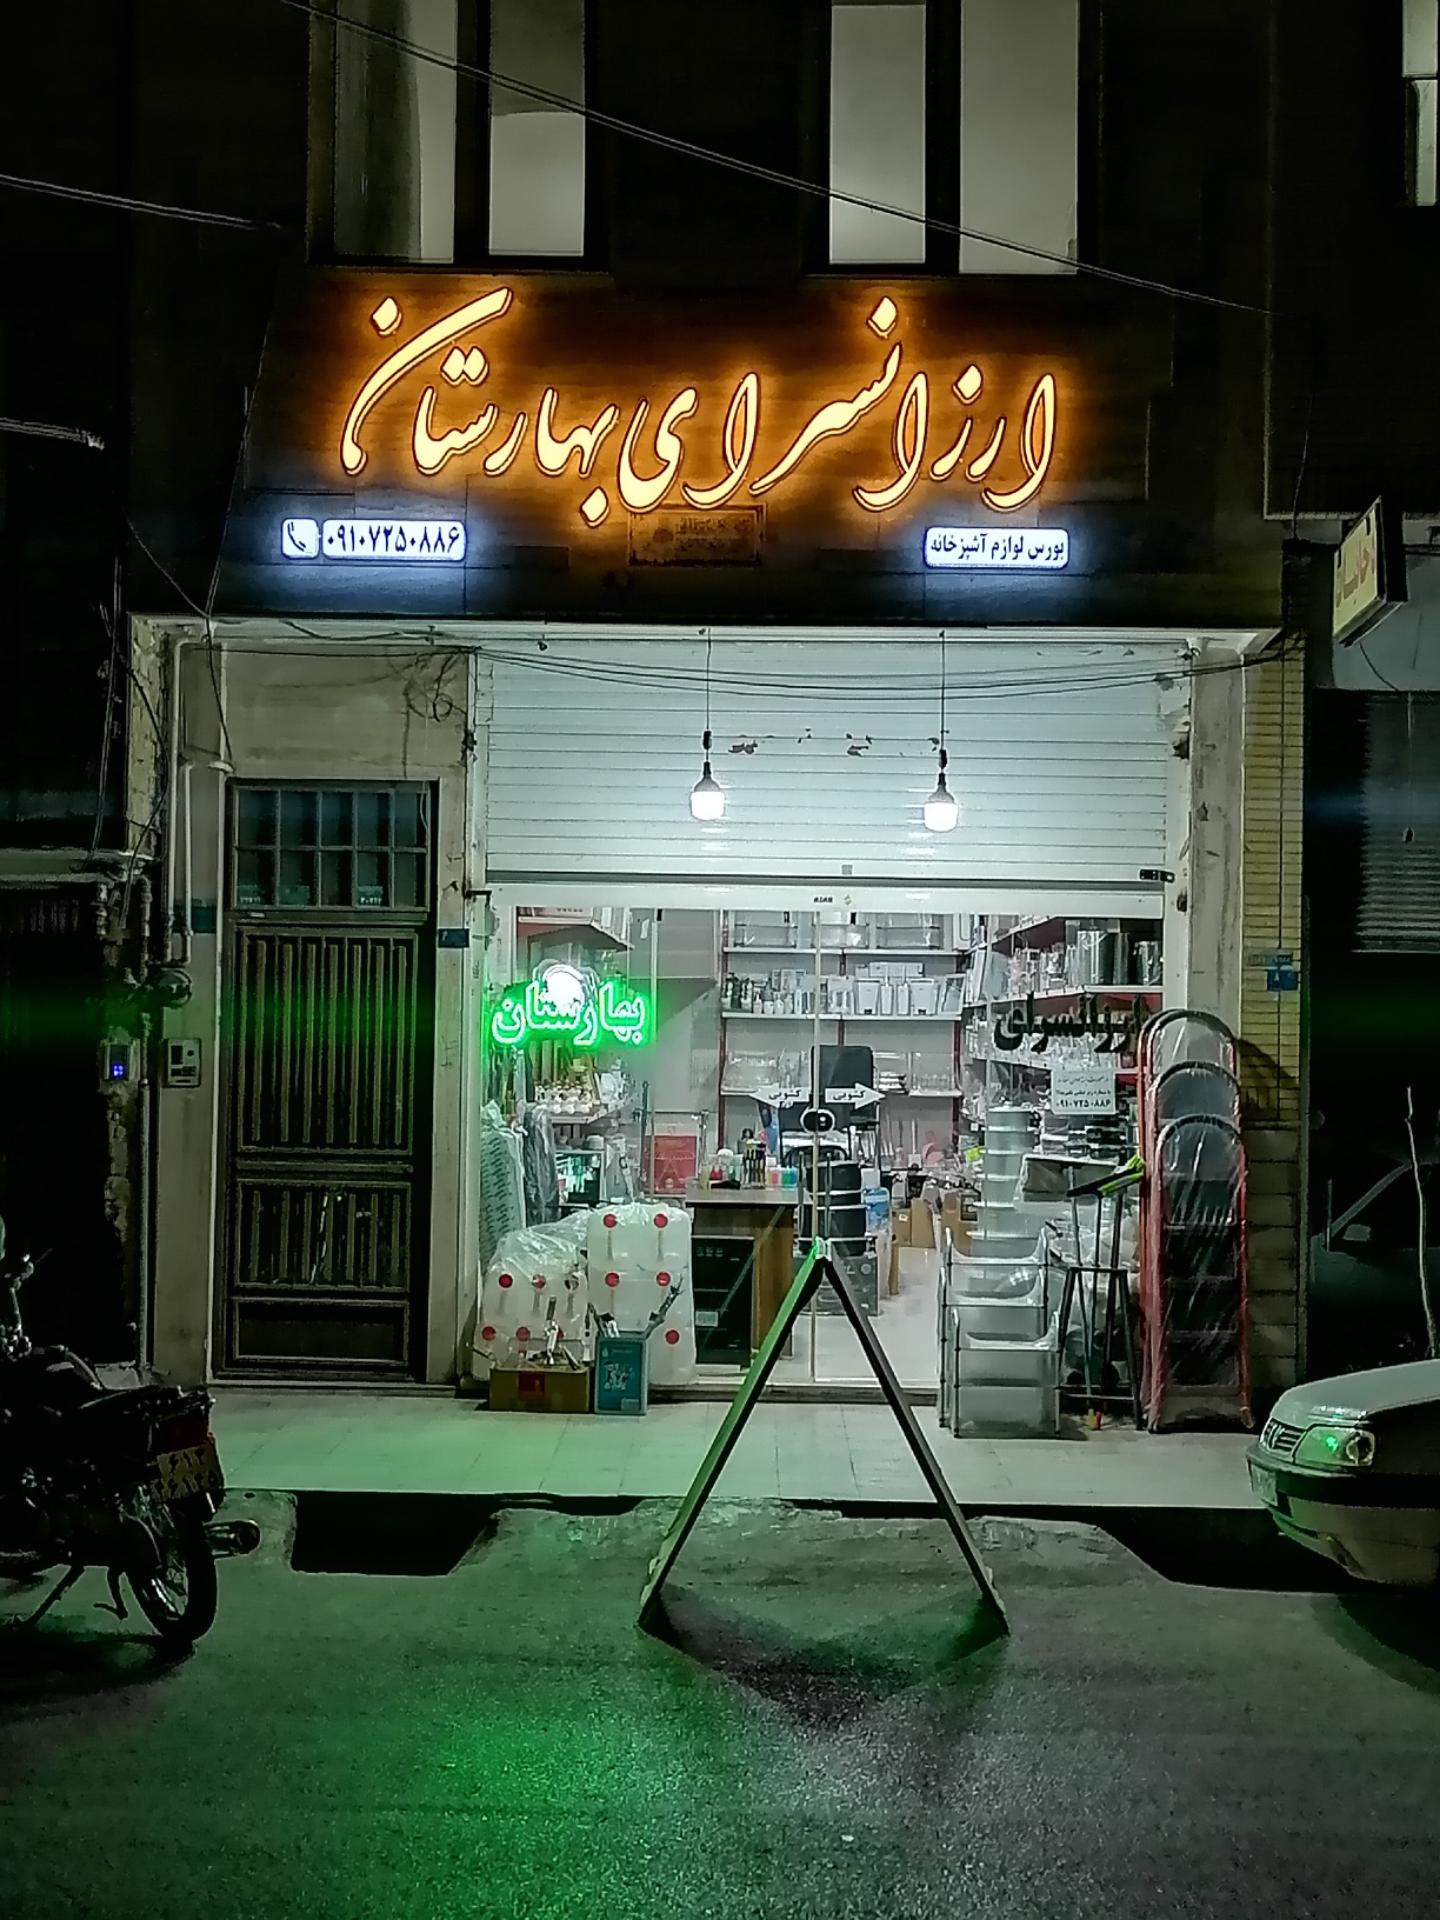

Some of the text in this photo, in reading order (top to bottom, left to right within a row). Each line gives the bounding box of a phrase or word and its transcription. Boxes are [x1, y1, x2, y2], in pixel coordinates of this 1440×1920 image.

[340, 286, 620, 528] بهارستان
[327, 524, 460, 553] ۰۹۱۰۷۲۵۰۸۸۶
[931, 533, 1064, 561] بورس لوازم آشپزخانه
[492, 979, 646, 1046] بهارستان
